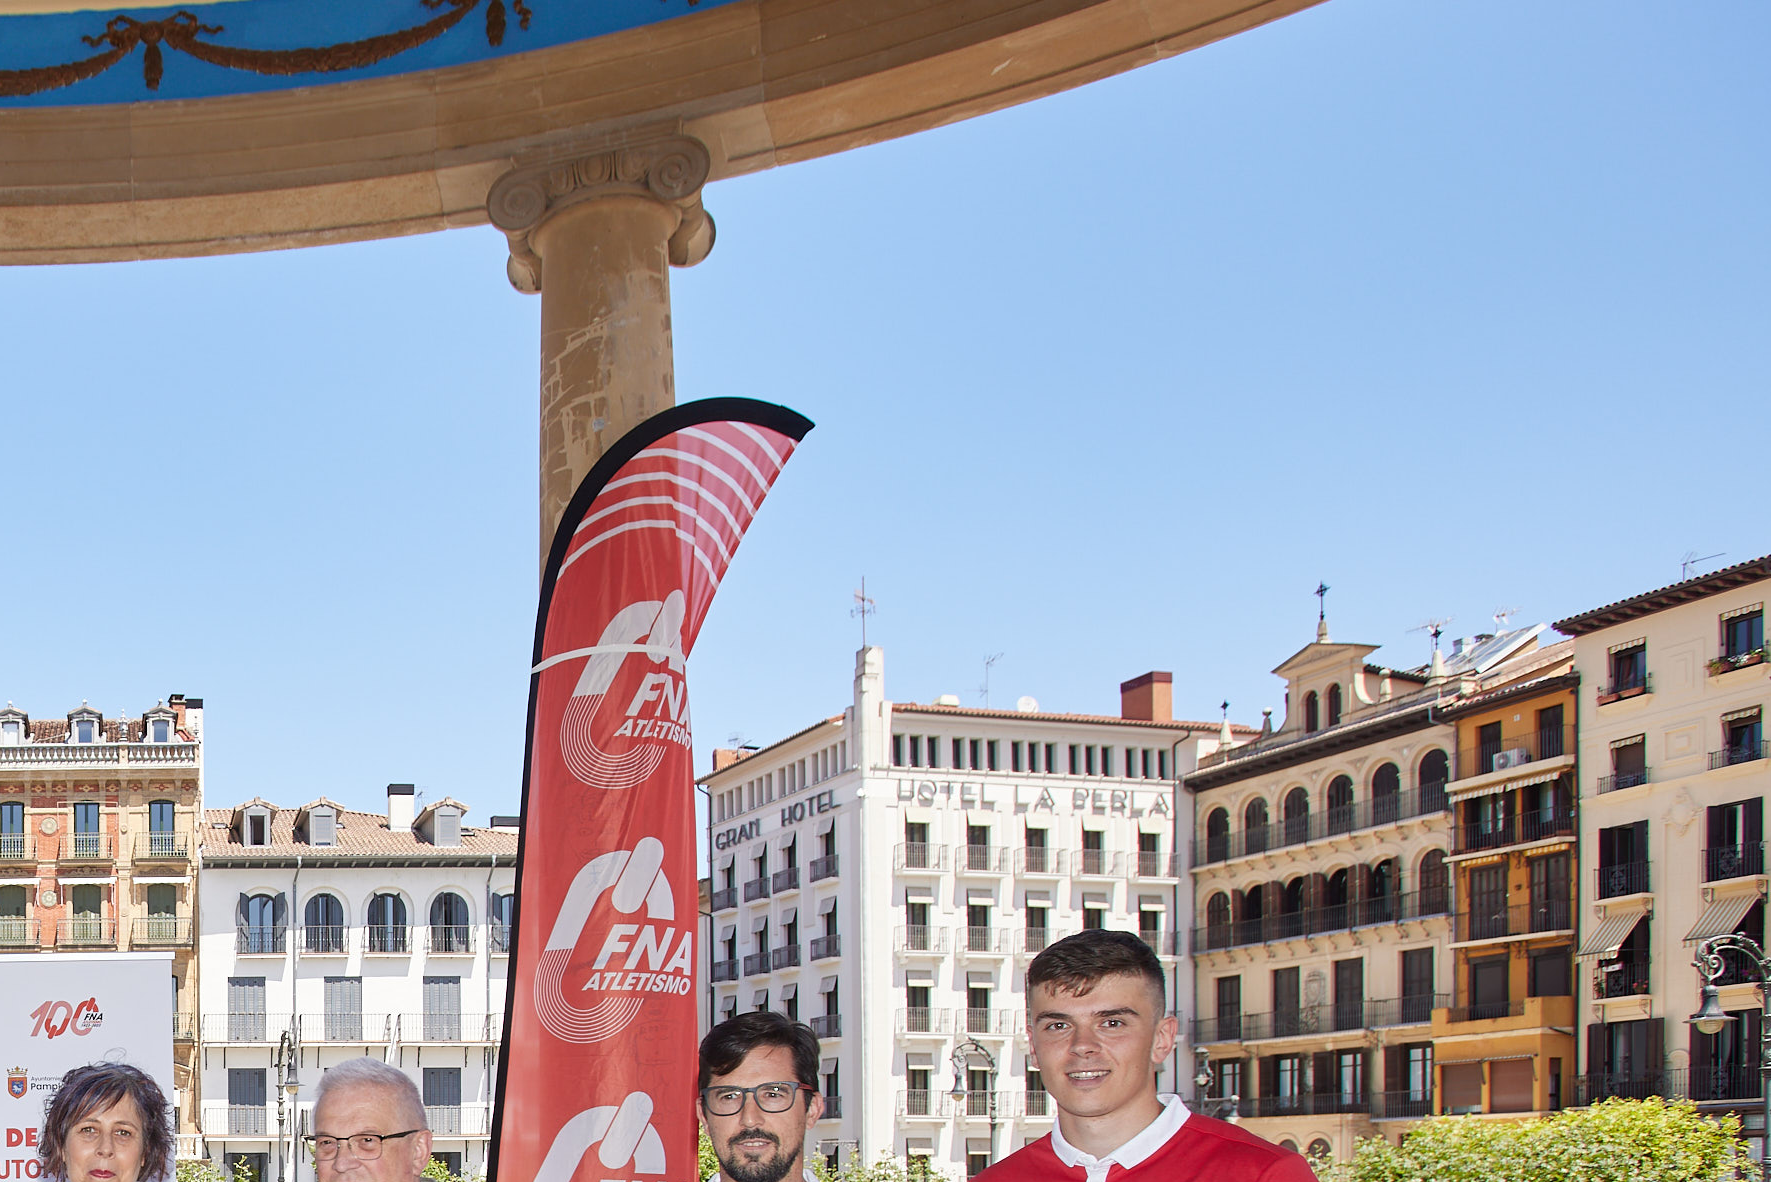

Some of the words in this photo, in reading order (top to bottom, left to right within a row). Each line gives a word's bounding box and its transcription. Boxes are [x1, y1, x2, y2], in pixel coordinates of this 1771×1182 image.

[898, 779, 995, 806] HOTEL
[1015, 785, 1055, 810] LA
[1072, 788, 1169, 814] PERLA
[715, 818, 760, 850] GRAN
[781, 789, 842, 827] HOTEL
[592, 923, 692, 976] FNA
[581, 972, 691, 996] ATLETISMO
[6, 1128, 38, 1147] DE
